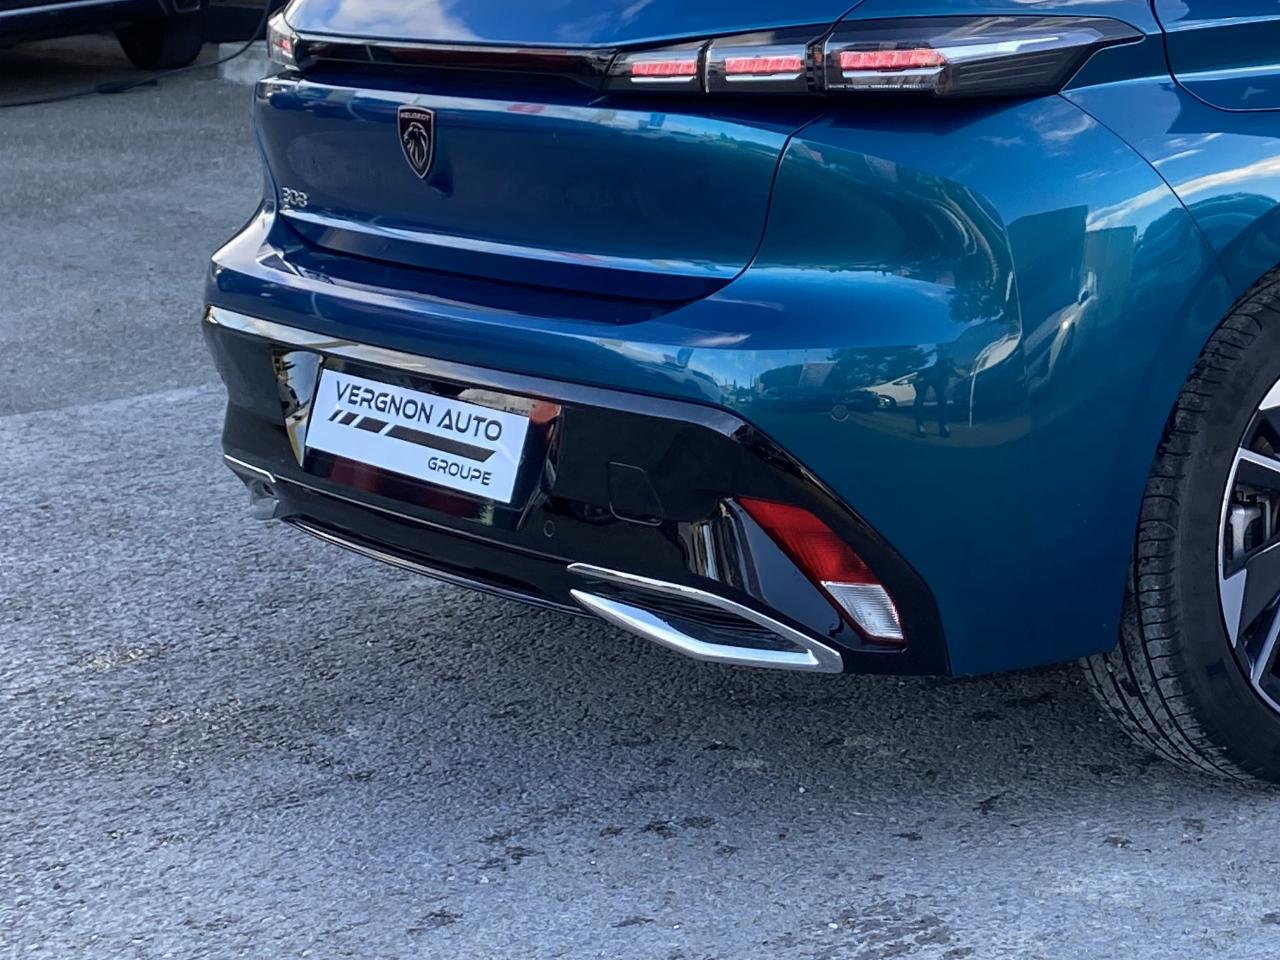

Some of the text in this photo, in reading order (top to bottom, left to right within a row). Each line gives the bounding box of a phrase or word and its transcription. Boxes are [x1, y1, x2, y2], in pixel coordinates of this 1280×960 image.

[336, 380, 503, 442] VERGNON AUTO
[428, 456, 493, 486] GROUPE
